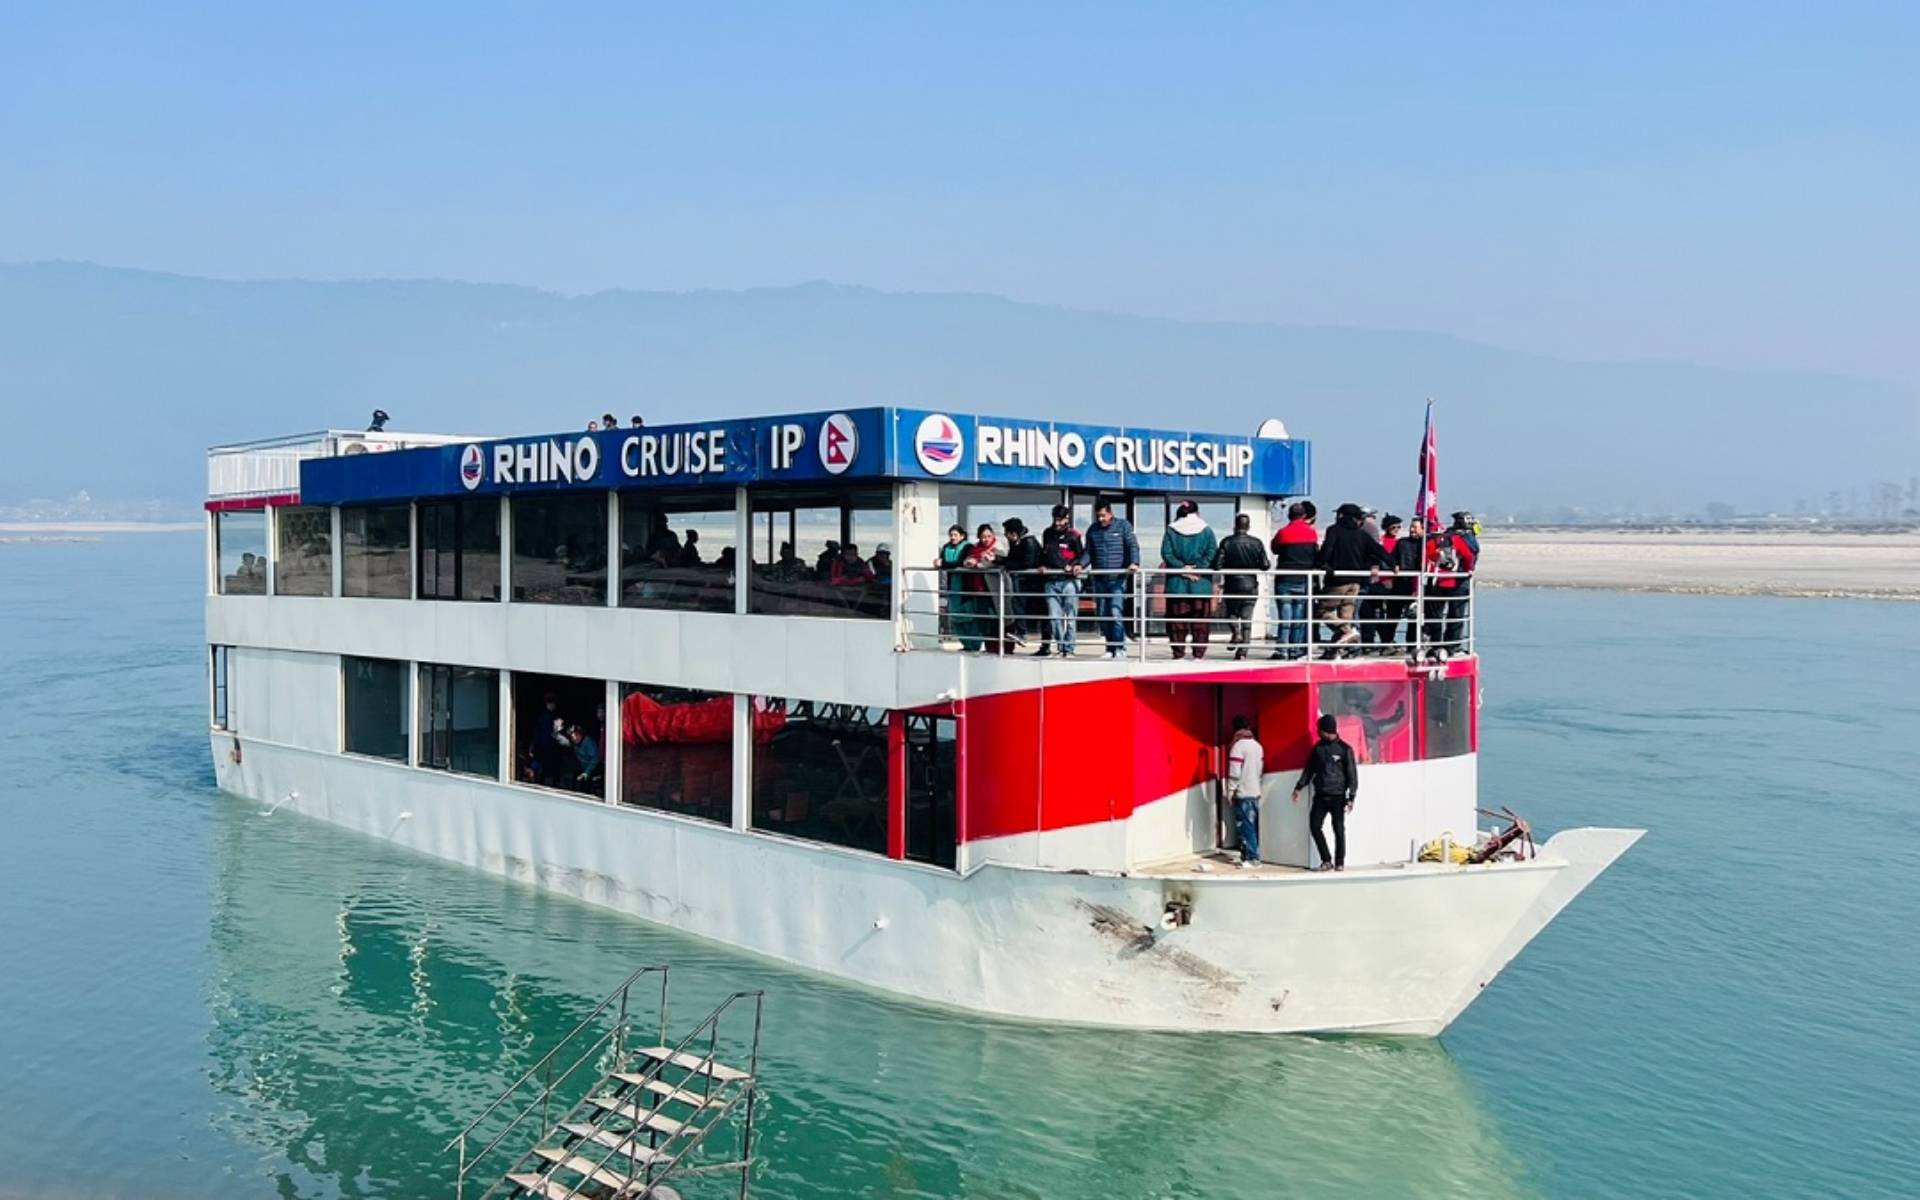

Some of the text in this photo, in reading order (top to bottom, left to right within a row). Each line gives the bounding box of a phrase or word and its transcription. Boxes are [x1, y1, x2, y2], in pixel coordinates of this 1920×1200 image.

[493, 436, 598, 484] RHINO
[977, 426, 1255, 478] RHINO CRUISESHIP
